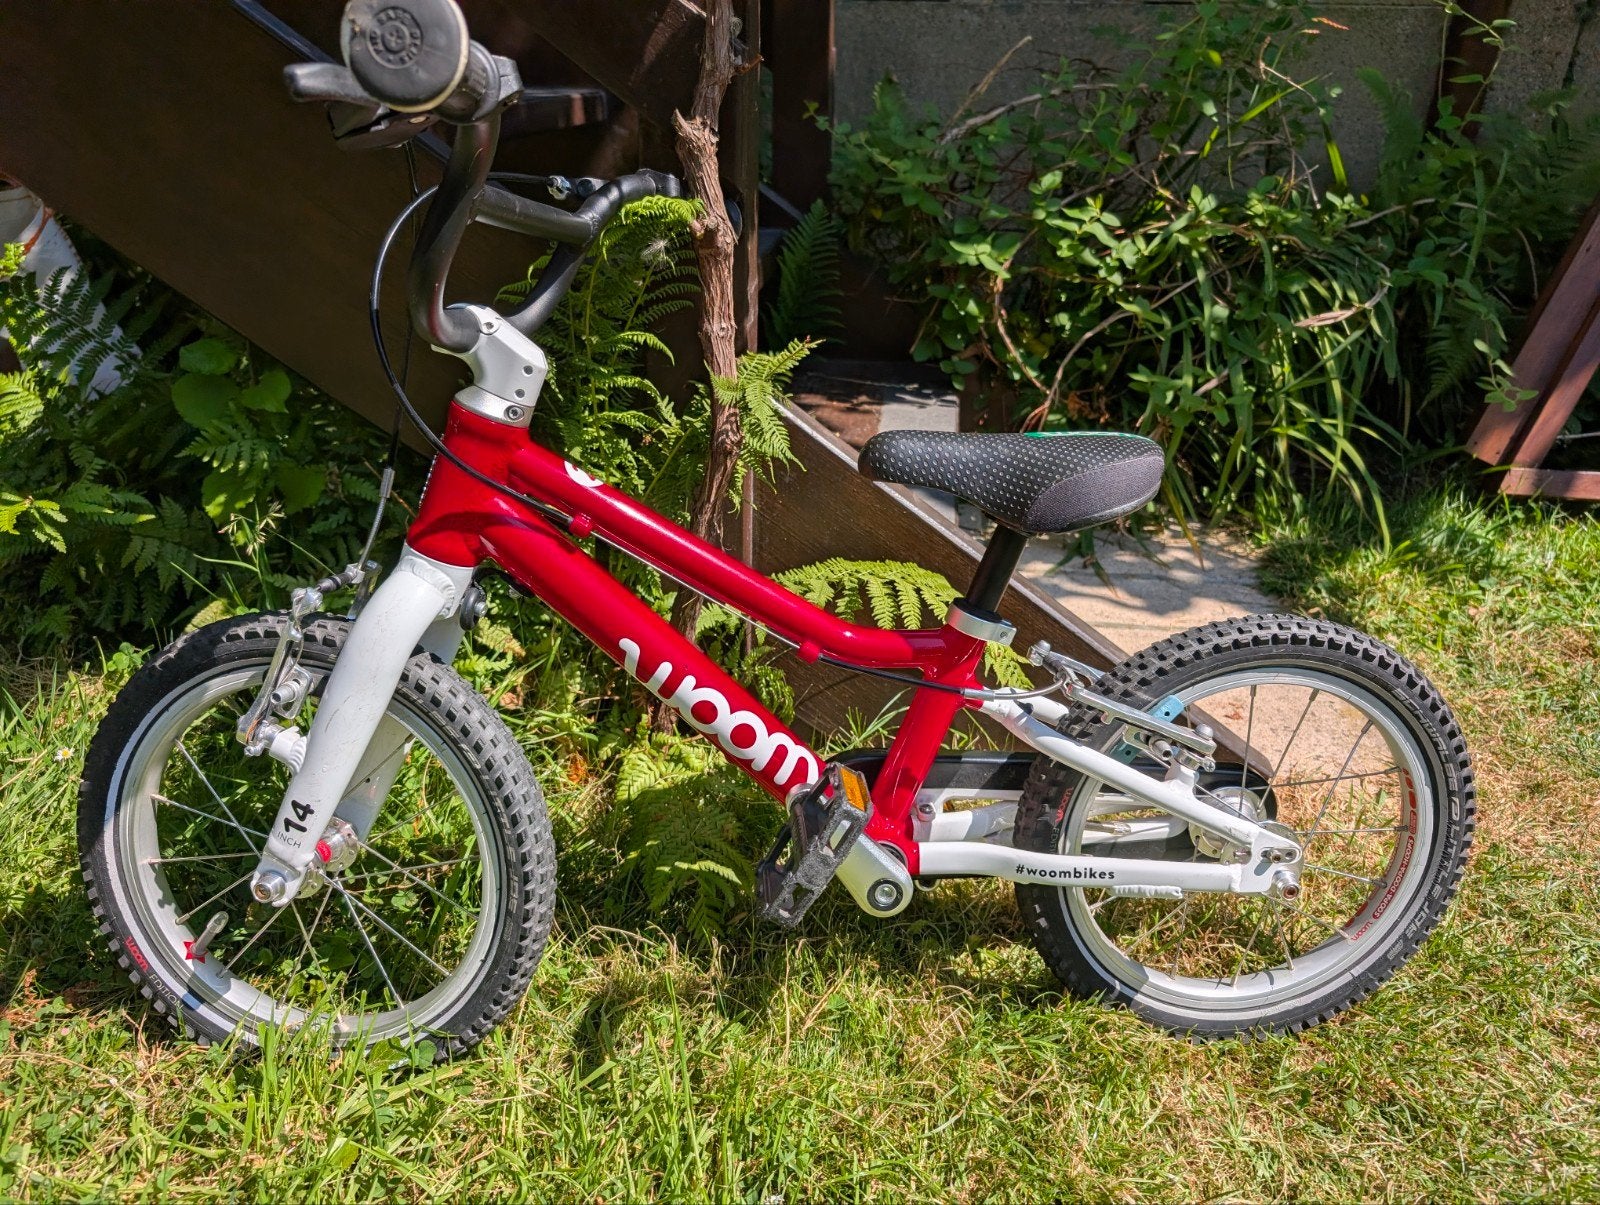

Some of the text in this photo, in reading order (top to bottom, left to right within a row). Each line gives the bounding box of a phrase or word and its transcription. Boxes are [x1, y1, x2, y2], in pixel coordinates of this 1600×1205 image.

[619, 638, 819, 786] woom
[284, 800, 315, 832] 14
[277, 831, 302, 848] INCH
[1016, 864, 1115, 879] #woombikes
[1351, 921, 1373, 941] woom
[123, 935, 184, 1010] woom EDITION
